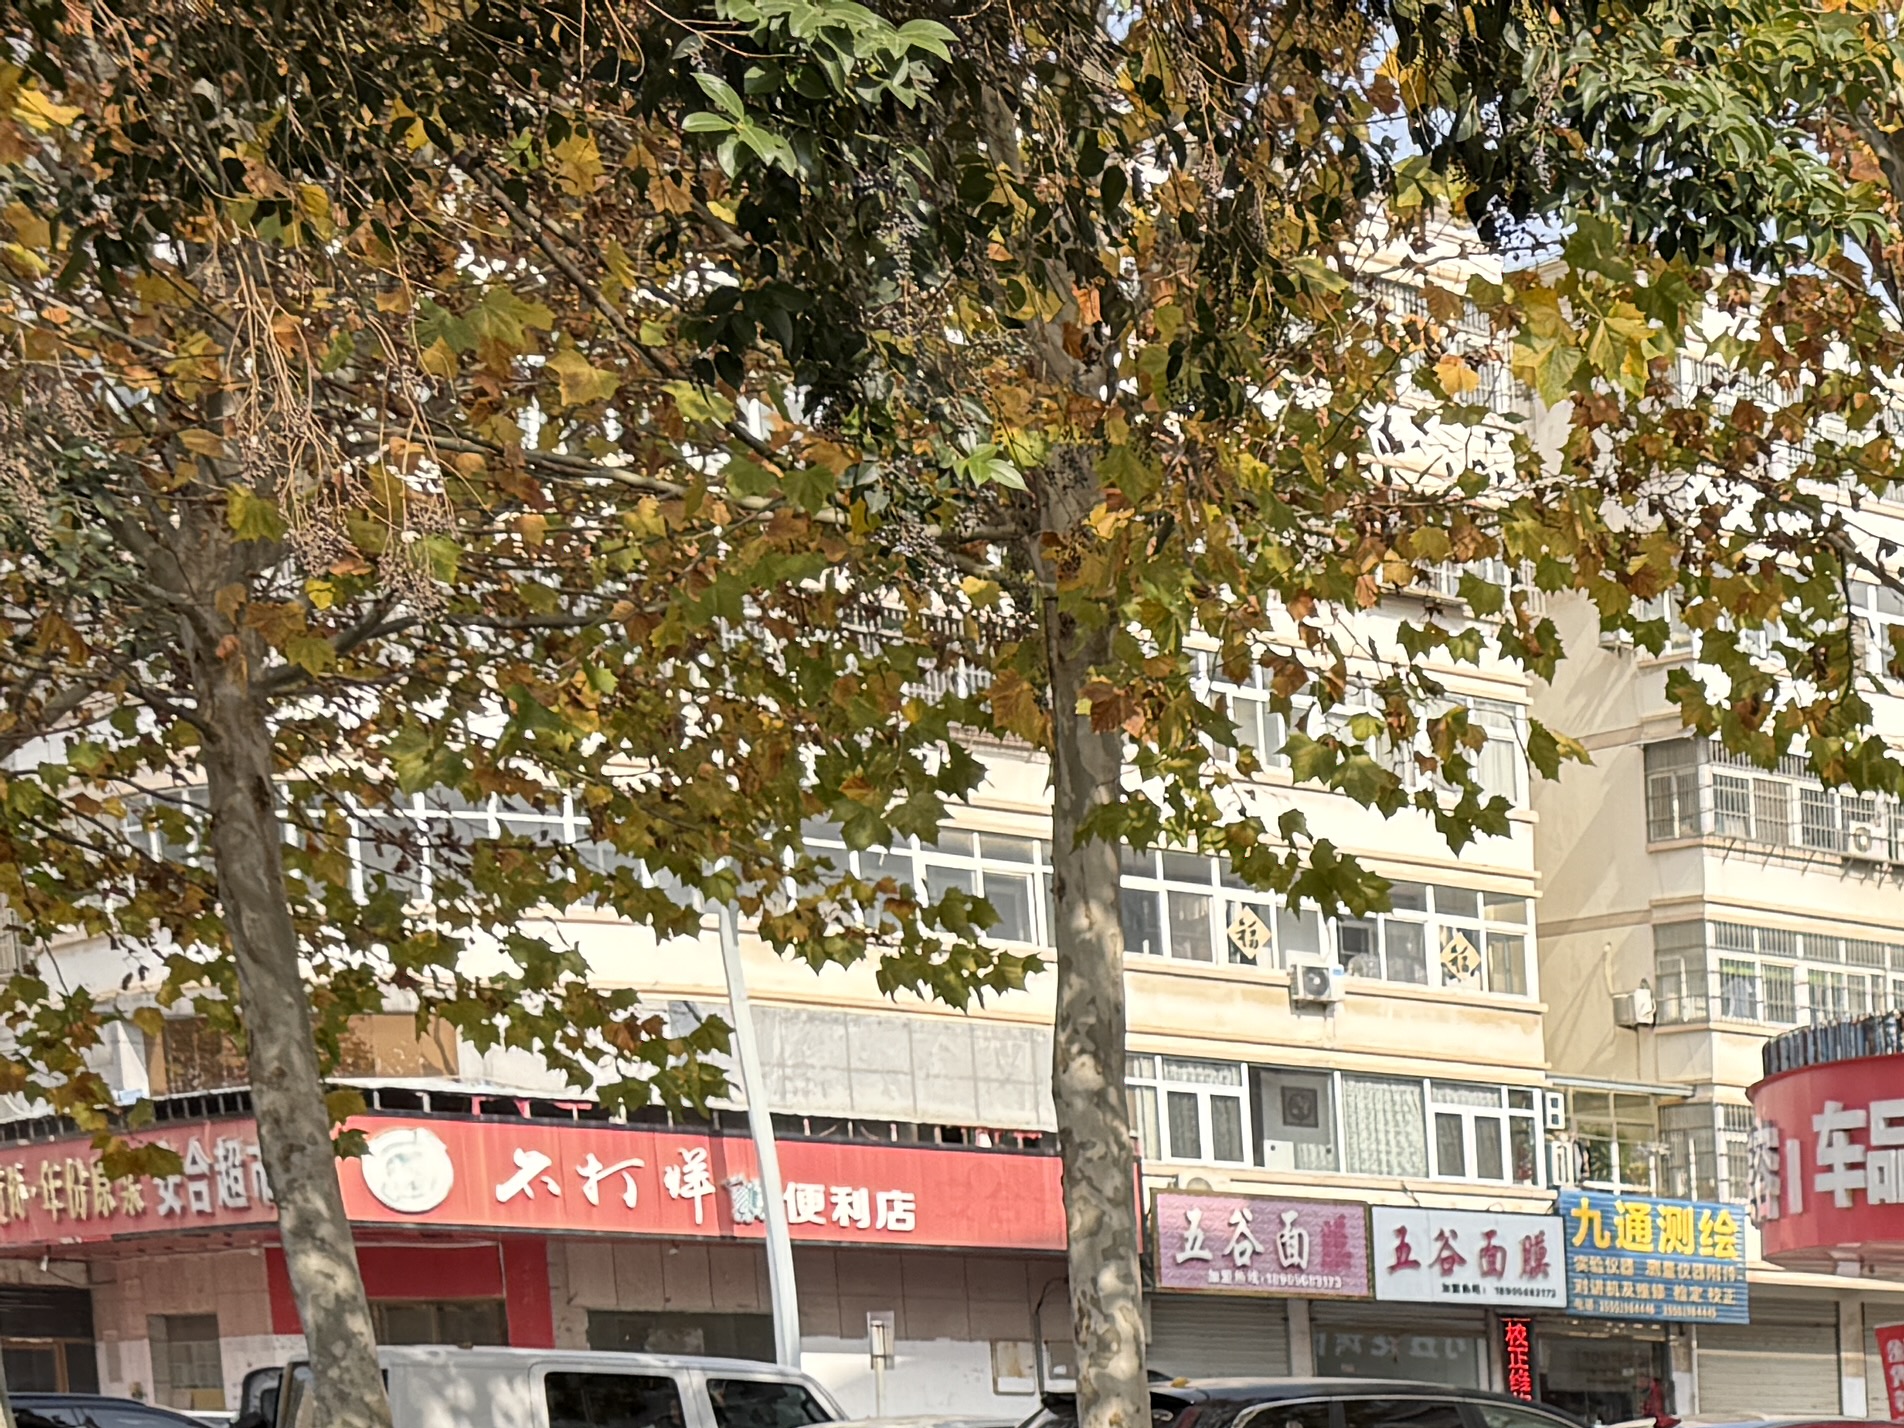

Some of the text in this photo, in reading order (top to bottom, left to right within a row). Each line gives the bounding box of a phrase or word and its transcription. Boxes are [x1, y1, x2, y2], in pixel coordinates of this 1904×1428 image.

[1234, 916, 1260, 950] 福
[1387, 1224, 1552, 1282] 五谷面膜
[1571, 1197, 1739, 1259] 九通测绘
[1503, 1320, 1533, 1402] 校正维
